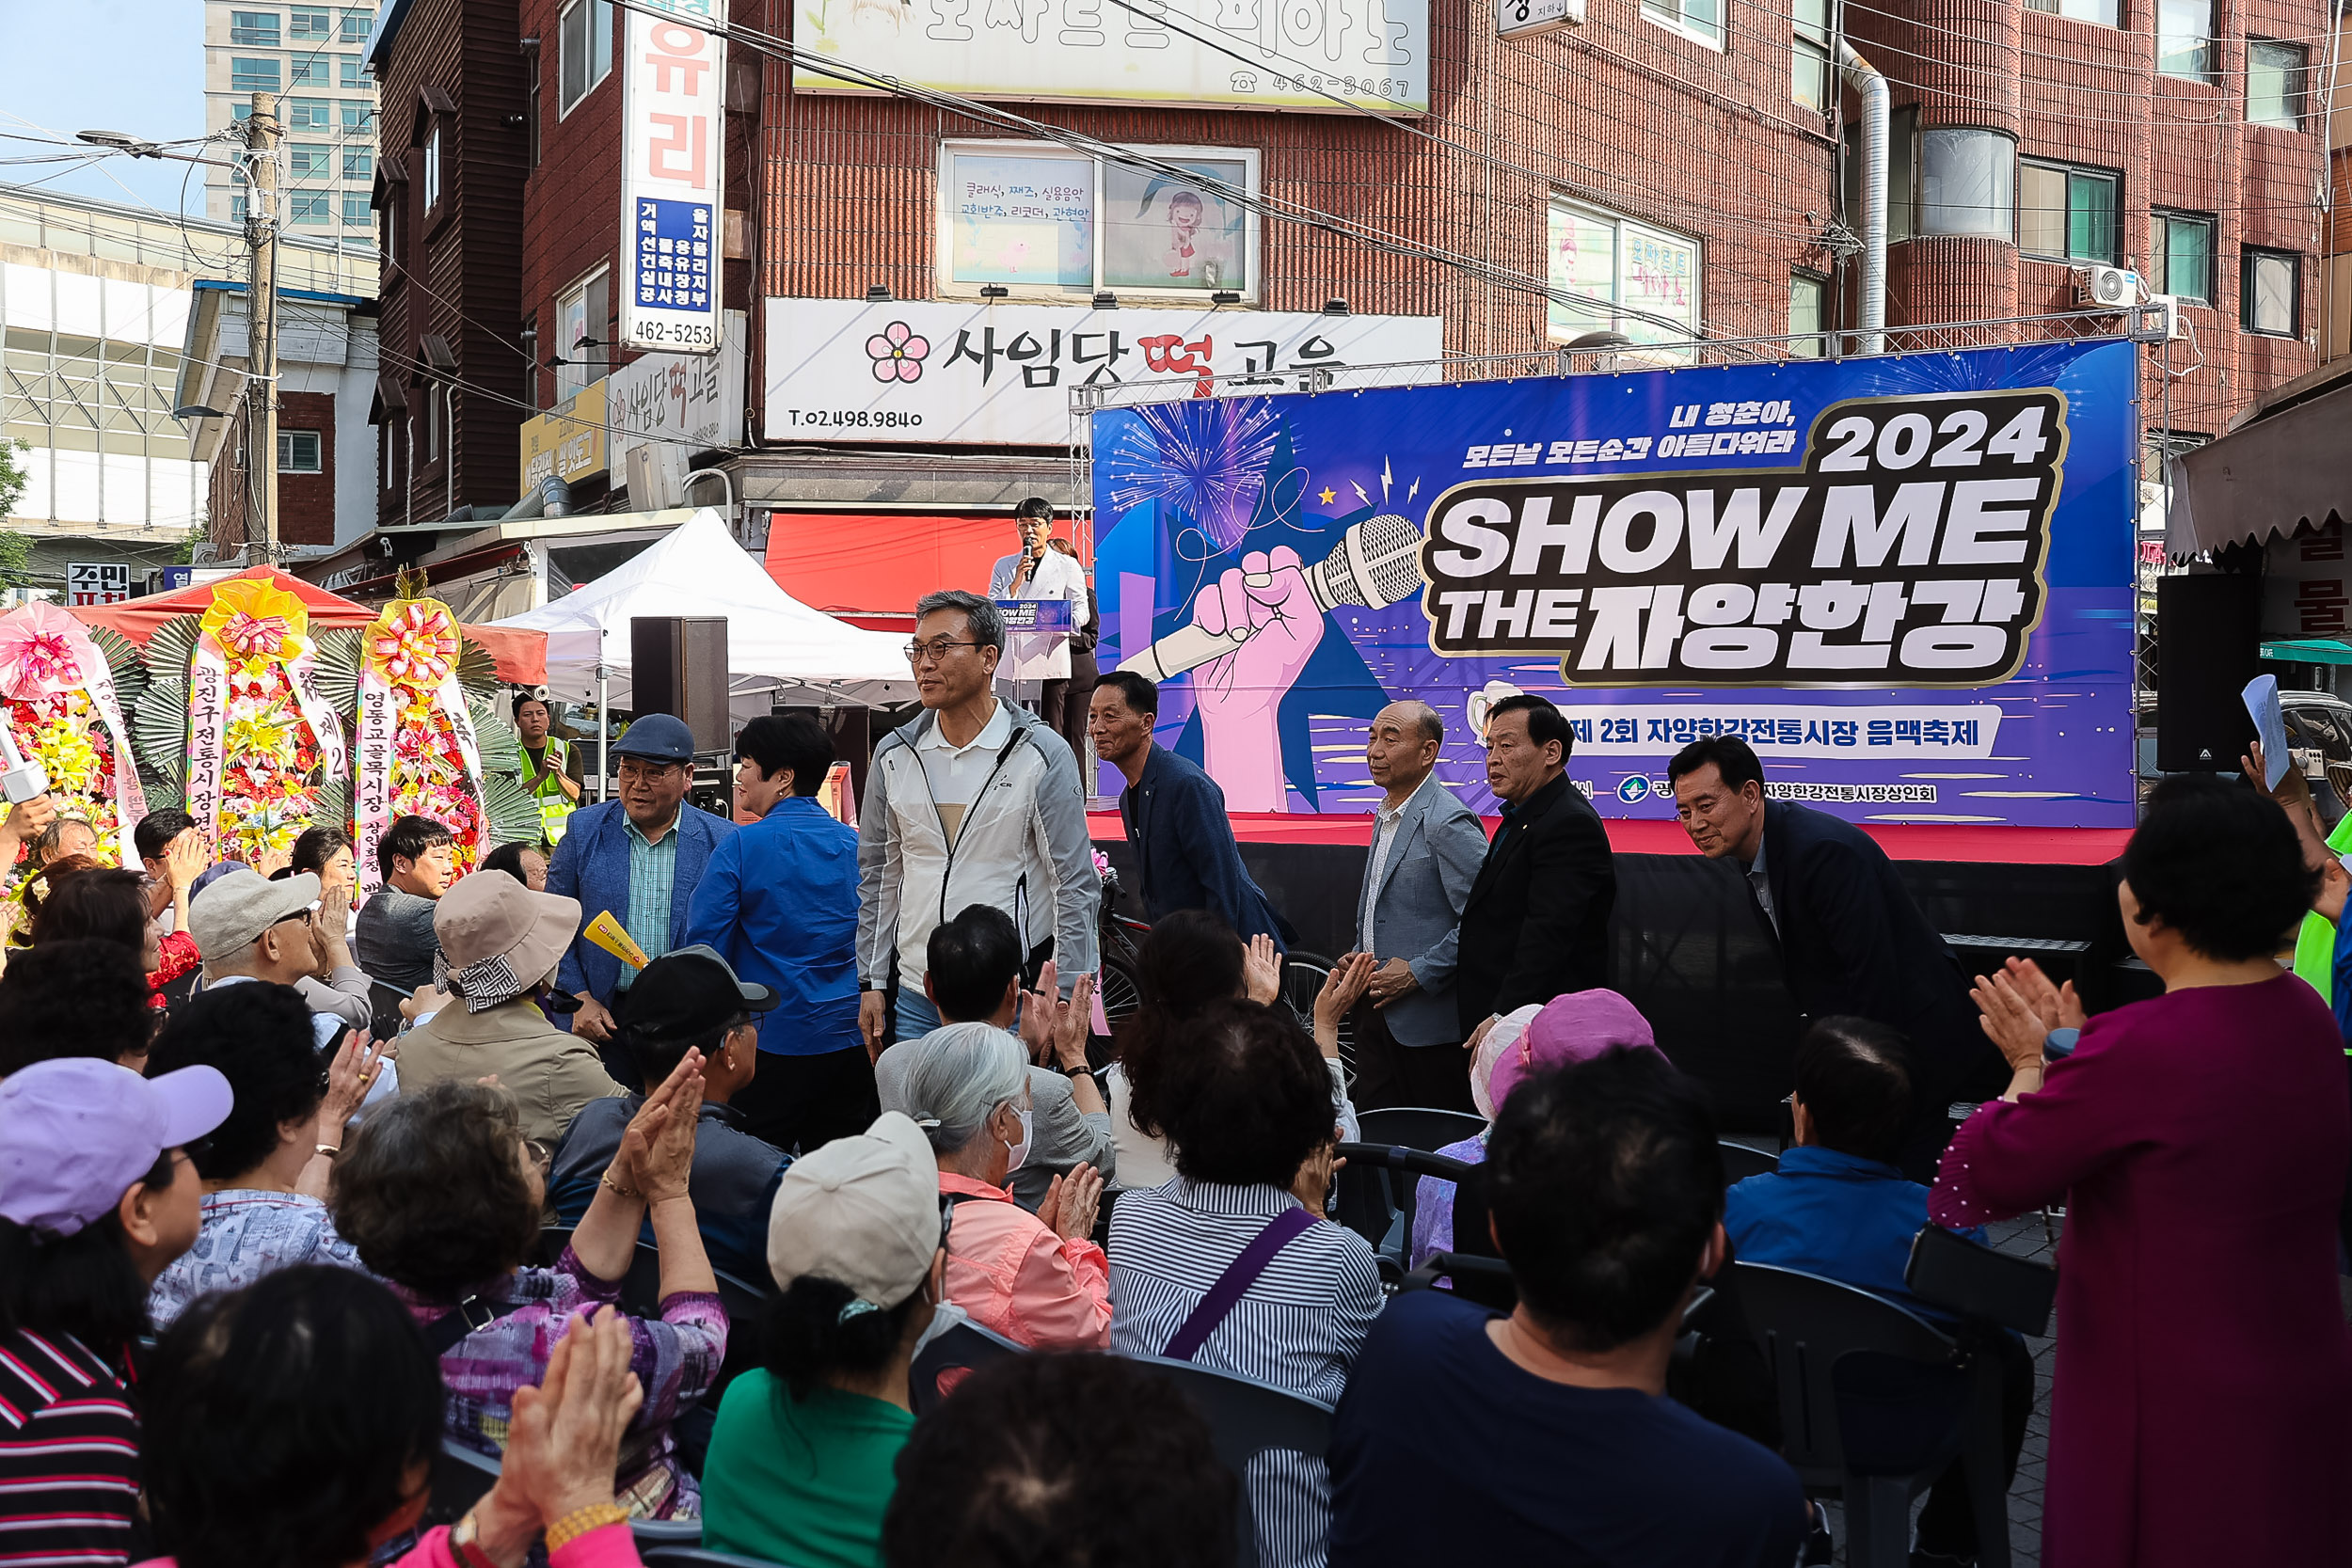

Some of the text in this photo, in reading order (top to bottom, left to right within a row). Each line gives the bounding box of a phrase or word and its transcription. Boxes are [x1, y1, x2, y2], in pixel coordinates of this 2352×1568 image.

[1537, 3, 1555, 16] 지하
[1273, 73, 1409, 97] 462-3067
[645, 21, 709, 189] 유리
[966, 182, 1005, 198] 클래식,
[1041, 186, 1084, 201] 실용음악
[961, 203, 1089, 222] 교회반주, 리코더, 관현악
[635, 321, 712, 344] 462-5253
[788, 408, 923, 429] T.02.498.9840
[1669, 400, 1795, 428] 내 청춘아,
[1462, 430, 1797, 468] 모든날 모든순간 아름다워라
[1818, 406, 2049, 472] 2024
[1433, 477, 2042, 578] SHOW ME
[72, 565, 128, 591] 주민
[1019, 609, 1037, 617] ME
[1438, 578, 2026, 671] THE 자양한강
[1570, 717, 1979, 747] 제 2회 자양한강전통시장 음맥축제
[191, 666, 222, 844] 광진구전통시장연
[1764, 782, 1937, 802] 자양한강전통시장상인회
